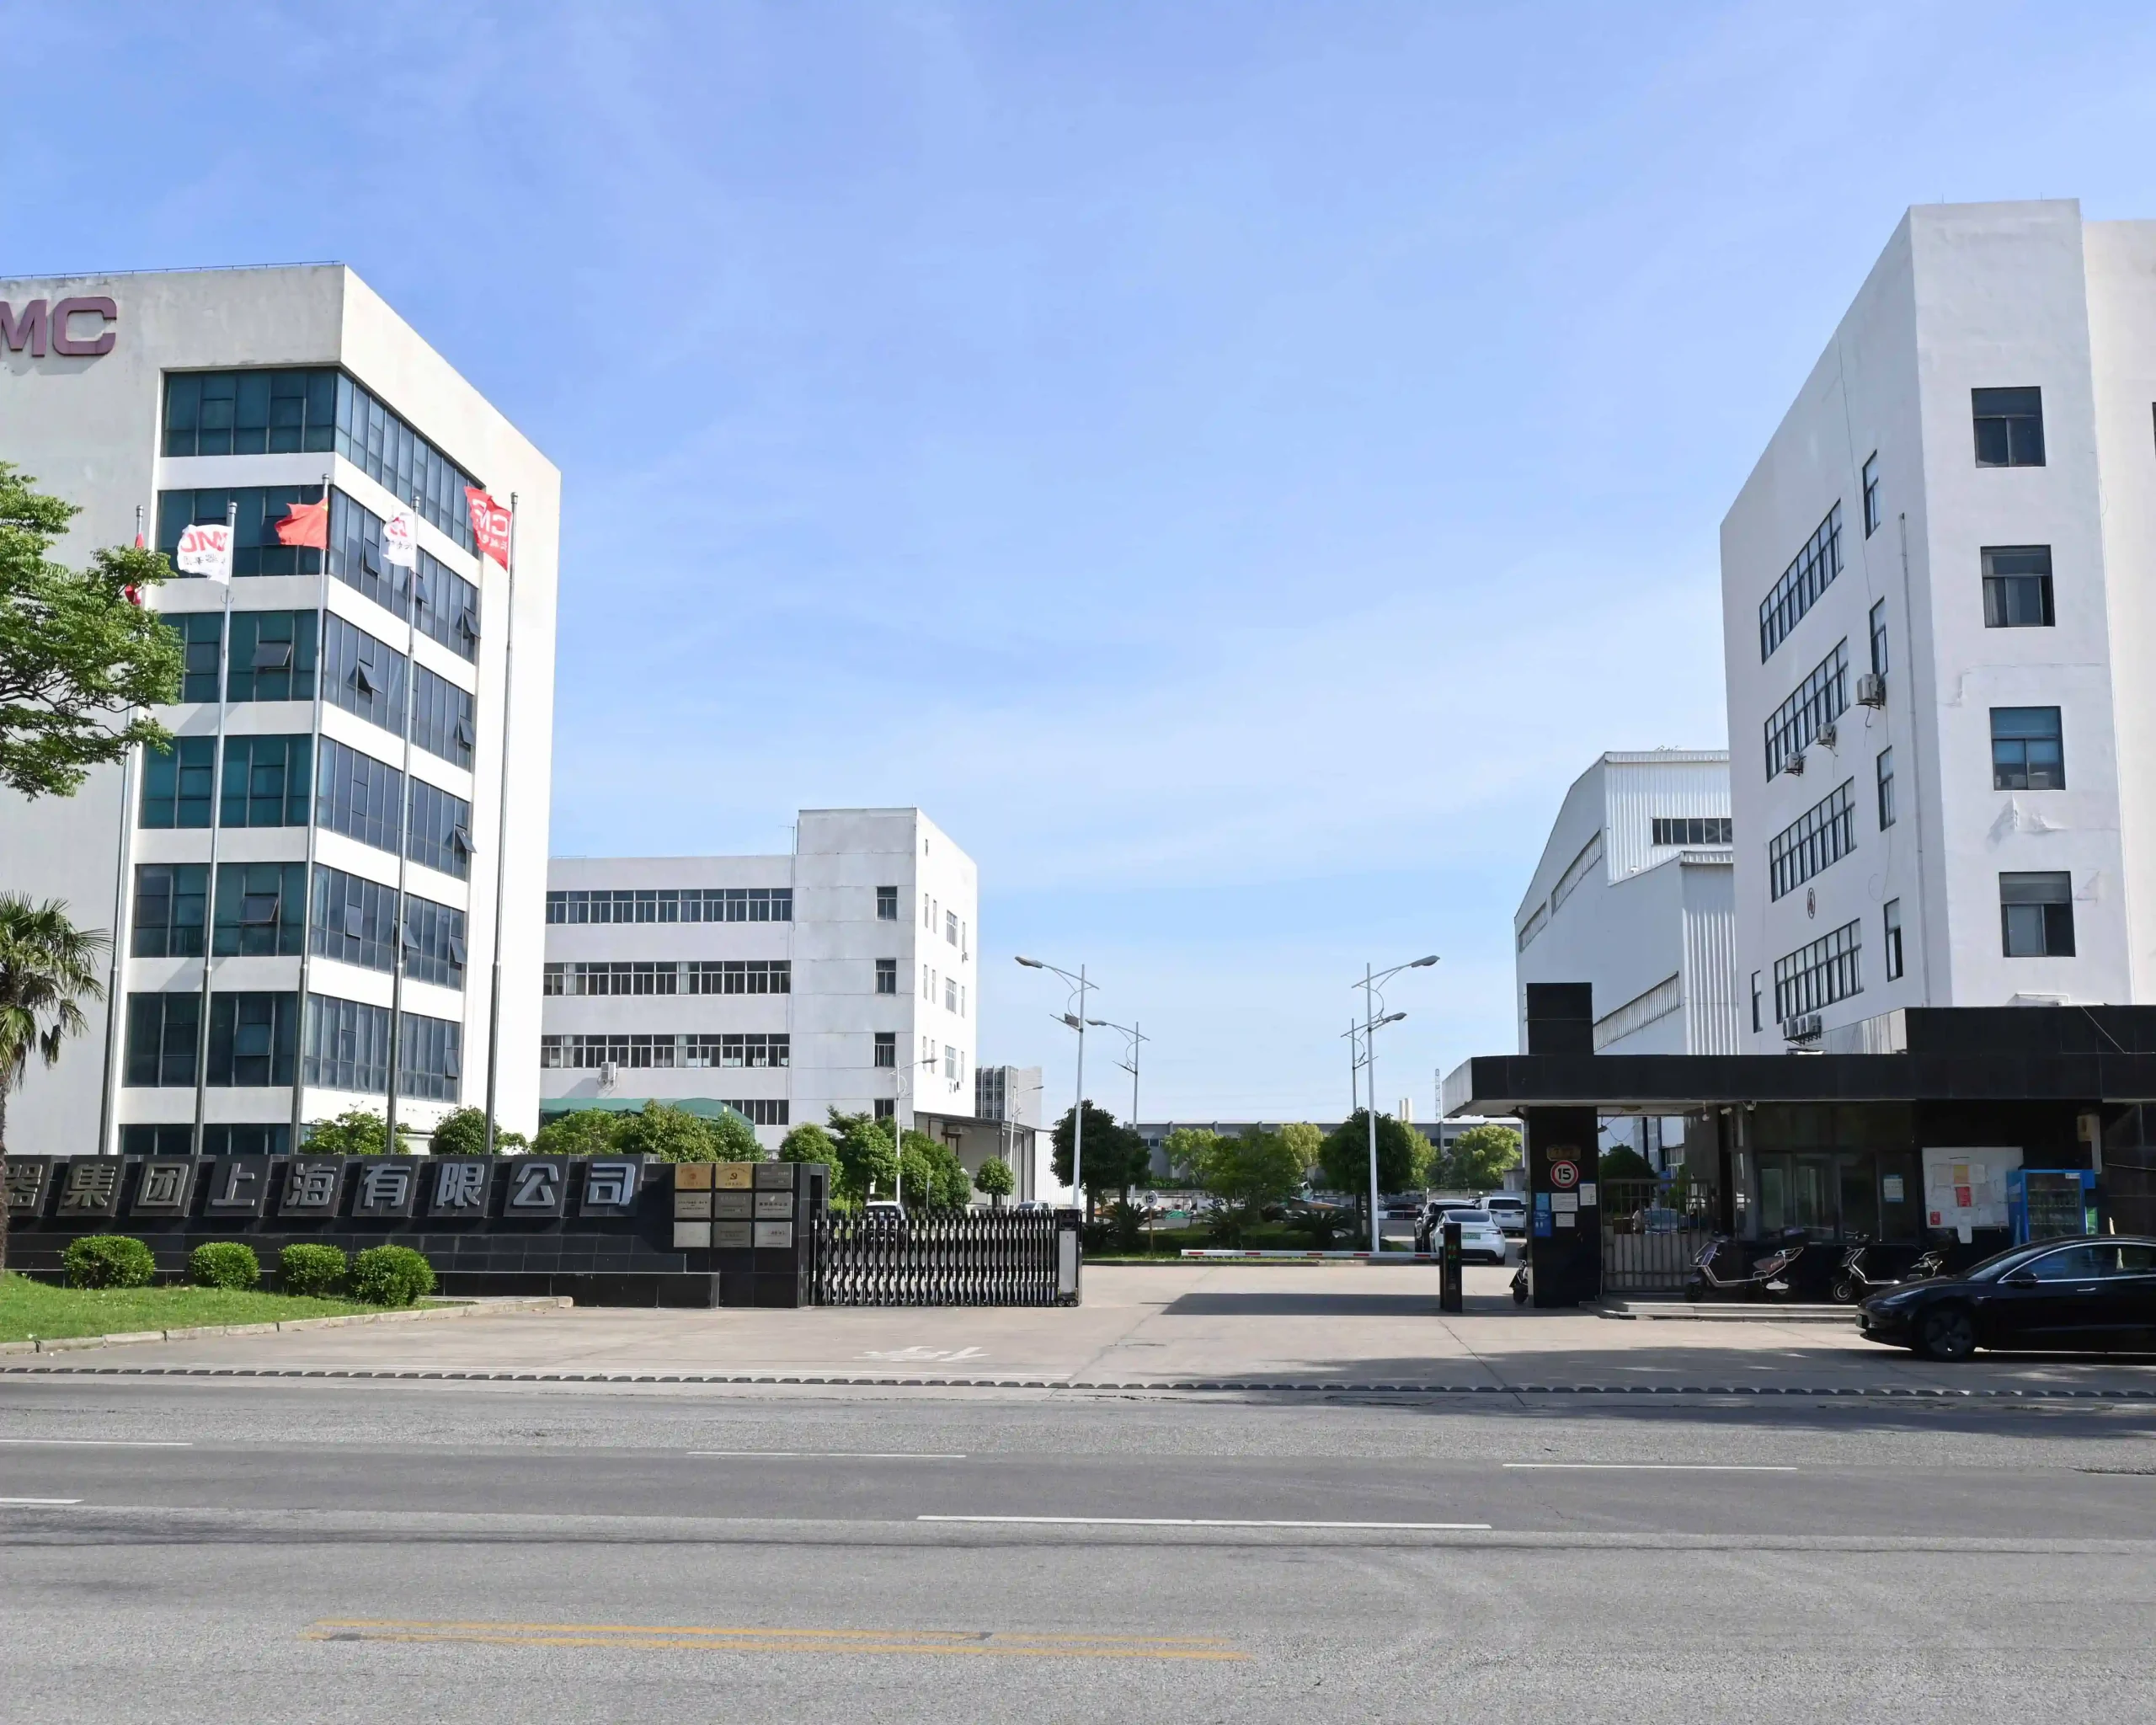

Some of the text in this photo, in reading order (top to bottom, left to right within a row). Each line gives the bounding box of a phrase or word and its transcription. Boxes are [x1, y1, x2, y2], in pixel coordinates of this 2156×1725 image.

[1558, 1167, 1572, 1180] 15
[4, 1163, 636, 1207] 器集团上海有限公司
[1145, 1195, 1154, 1204] 15
